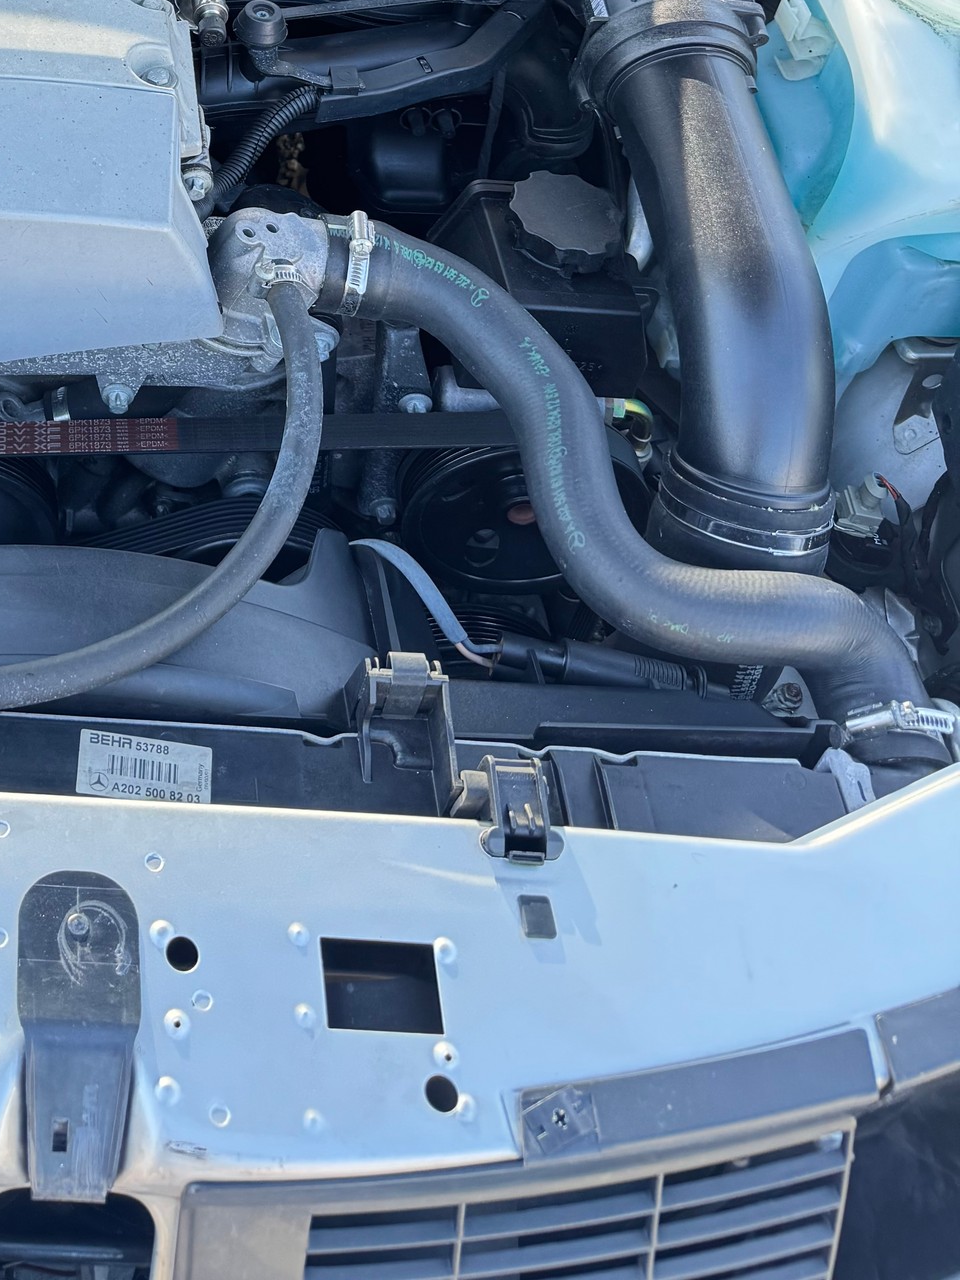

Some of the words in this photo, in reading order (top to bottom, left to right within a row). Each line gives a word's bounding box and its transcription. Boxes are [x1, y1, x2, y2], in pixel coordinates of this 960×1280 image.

[68, 425, 112, 434] 6PK1873
[68, 433, 112, 442] 6PK1873
[68, 441, 112, 450] 6PK1873
[89, 732, 133, 749] BEHR
[135, 741, 170, 755] 53788
[196, 763, 205, 792] Germany
[111, 782, 141, 796] A202
[145, 787, 166, 799] 500
[169, 790, 183, 802] 82
[186, 793, 200, 804] 03
